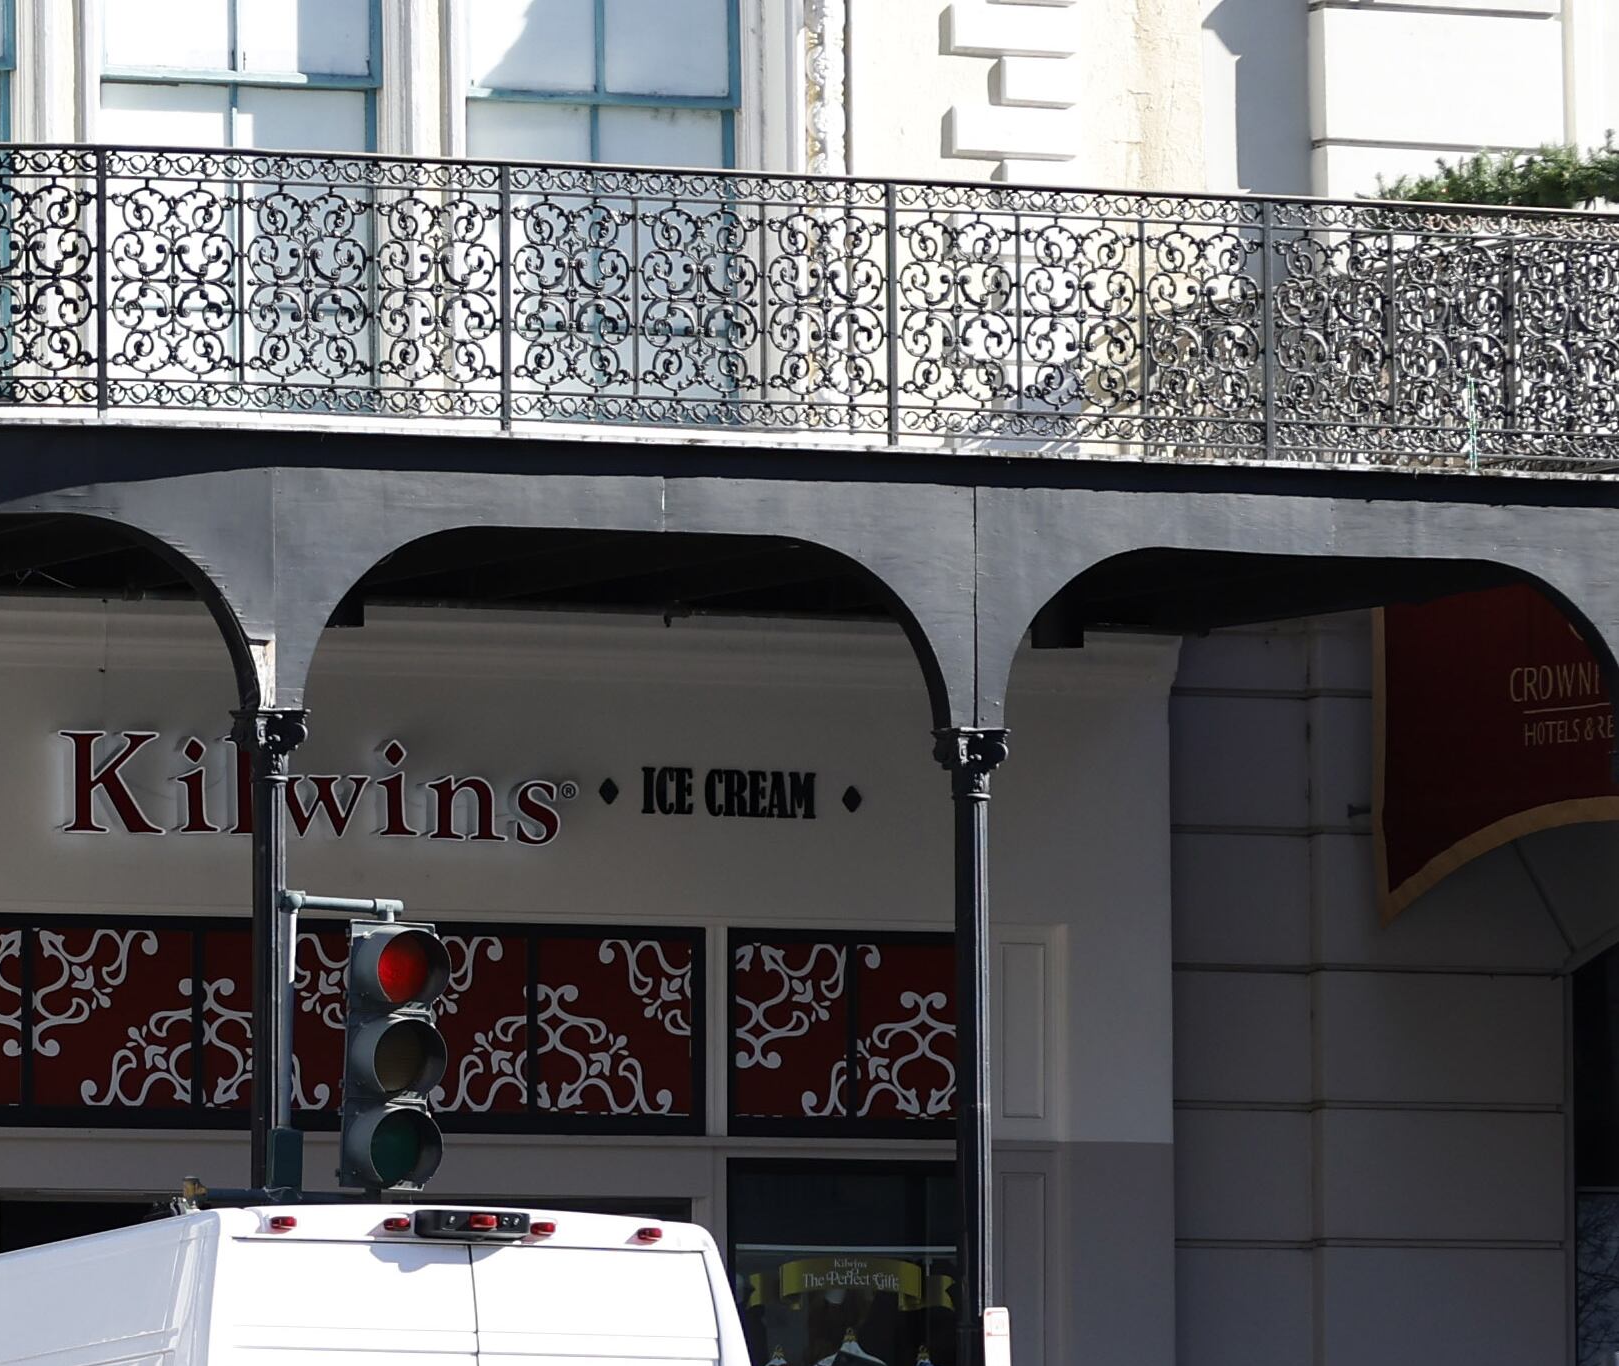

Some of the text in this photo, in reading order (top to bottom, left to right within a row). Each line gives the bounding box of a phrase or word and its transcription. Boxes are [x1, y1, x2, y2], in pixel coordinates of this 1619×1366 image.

[1524, 718, 1580, 746] HOTELS
[58, 730, 561, 846] Kilwins
[641, 766, 817, 820] ICE CREAM
[833, 1259, 868, 1269] Kilwins
[802, 1272, 825, 1289] The
[825, 1269, 871, 1286] Perfect
